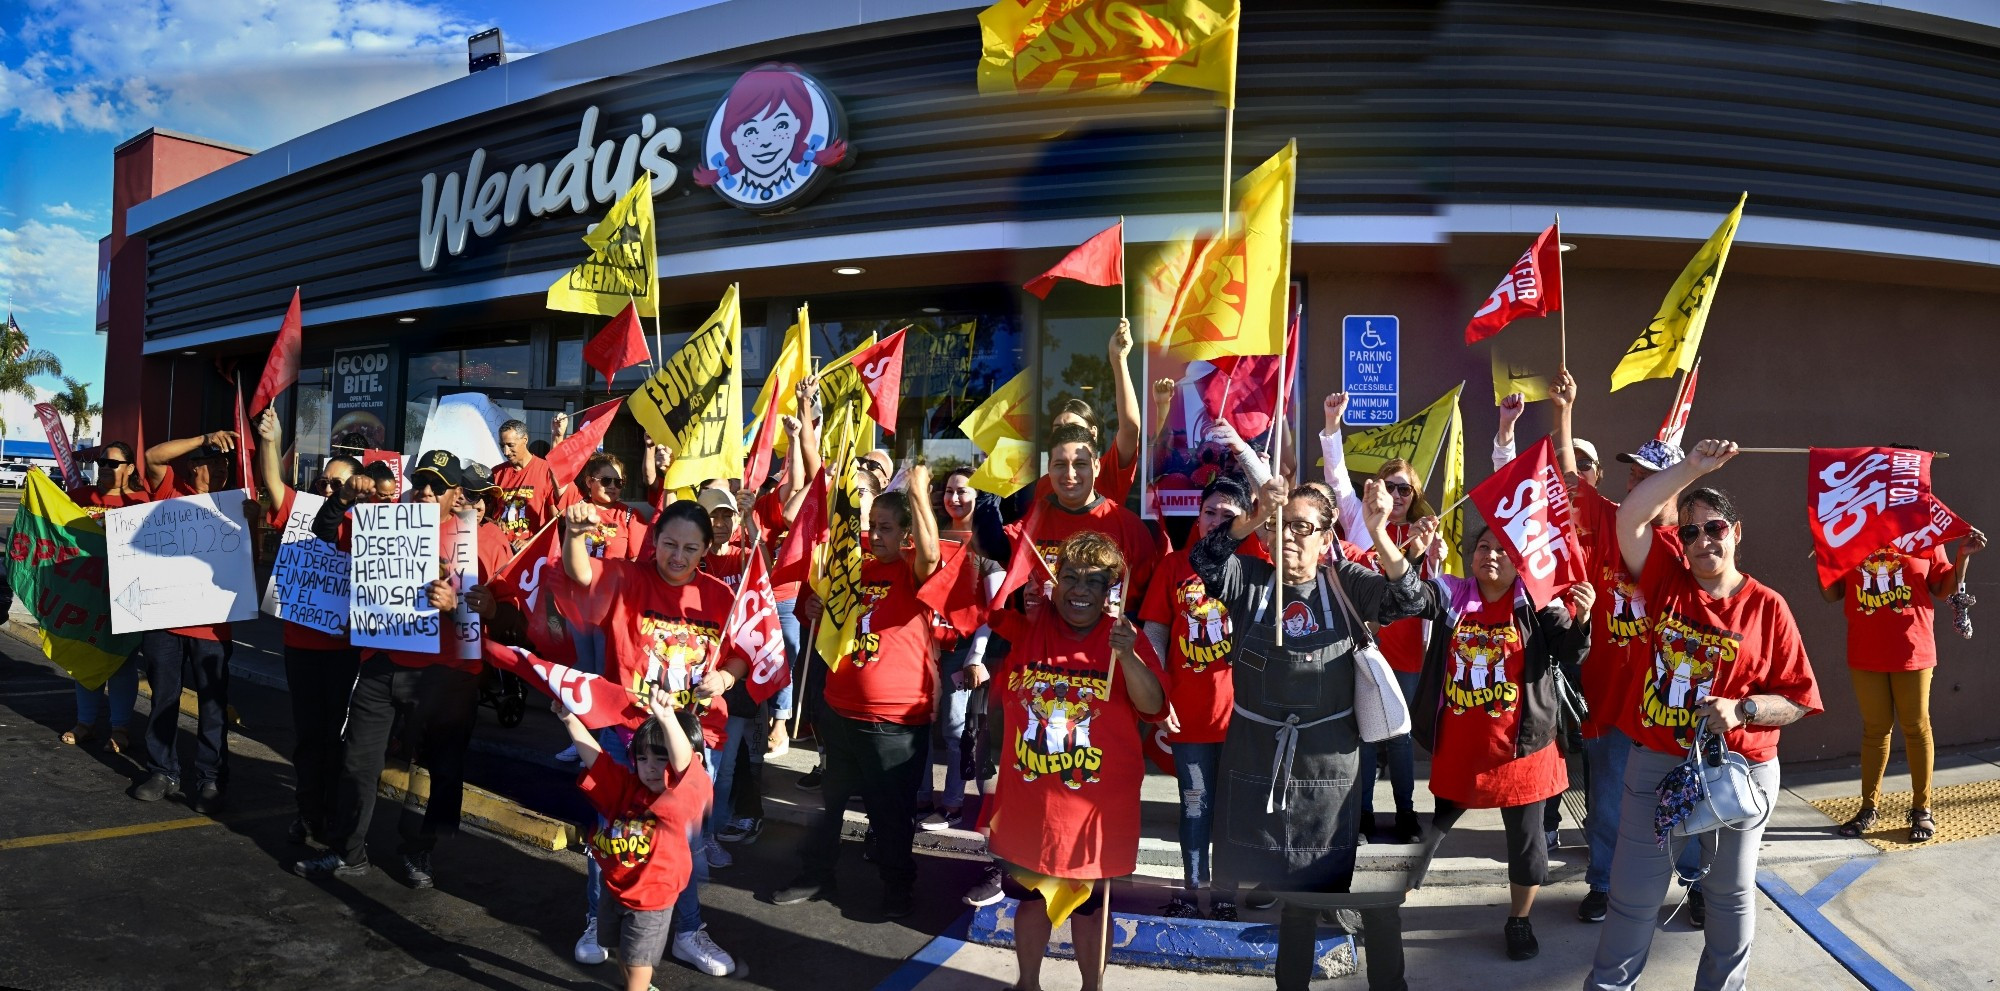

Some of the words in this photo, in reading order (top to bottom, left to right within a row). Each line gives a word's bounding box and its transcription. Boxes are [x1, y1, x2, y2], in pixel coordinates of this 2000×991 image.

[418, 105, 683, 271] Wendy's
[1515, 267, 1537, 300] FOR
[337, 353, 389, 375] GOOD
[1349, 350, 1392, 362] PARKING
[1358, 363, 1383, 374] ONLY
[343, 373, 383, 394] BITE.
[1348, 383, 1394, 391] ACCESSIBLE
[1363, 375, 1379, 383] VAN
[337, 401, 361, 409] MIDNIGHT
[368, 400, 385, 408] LATER
[1347, 410, 1367, 420] FINE
[1370, 409, 1394, 421] $250
[1352, 398, 1389, 408] MINIMUM
[1891, 451, 1921, 477] FIGHT
[1889, 478, 1919, 508] FOR
[109, 511, 138, 534] This
[142, 514, 151, 529] is
[153, 506, 178, 533] why
[178, 508, 193, 522] we
[195, 492, 222, 520] need
[354, 503, 389, 531] WE
[395, 503, 434, 531] ALL
[1930, 502, 1953, 531] FOR
[118, 520, 241, 560] #AB1228
[283, 530, 322, 555] DEBE
[353, 534, 431, 558] DESERVE
[279, 546, 301, 568] UN
[301, 552, 352, 578] DERECH
[355, 557, 428, 583] HEALTHY
[271, 583, 294, 600] EN
[297, 589, 318, 607] EL
[275, 565, 351, 598] FUNDAMENTA
[356, 584, 389, 607] AND
[1856, 585, 1913, 608] UNIDOS
[37, 588, 110, 644] UP!
[275, 601, 343, 631] TRABAJO
[353, 610, 439, 637] WORKPLACES
[640, 617, 722, 647] WORKERS
[1654, 611, 1740, 661] WORKERS
[1178, 633, 1233, 663] UNID
[1022, 668, 1108, 700] WORKERS
[1445, 671, 1518, 708] UNIDOS
[1643, 666, 1698, 728] UNIDO
[1014, 725, 1103, 774] UNIDOS
[593, 831, 650, 855] UNIDOS
